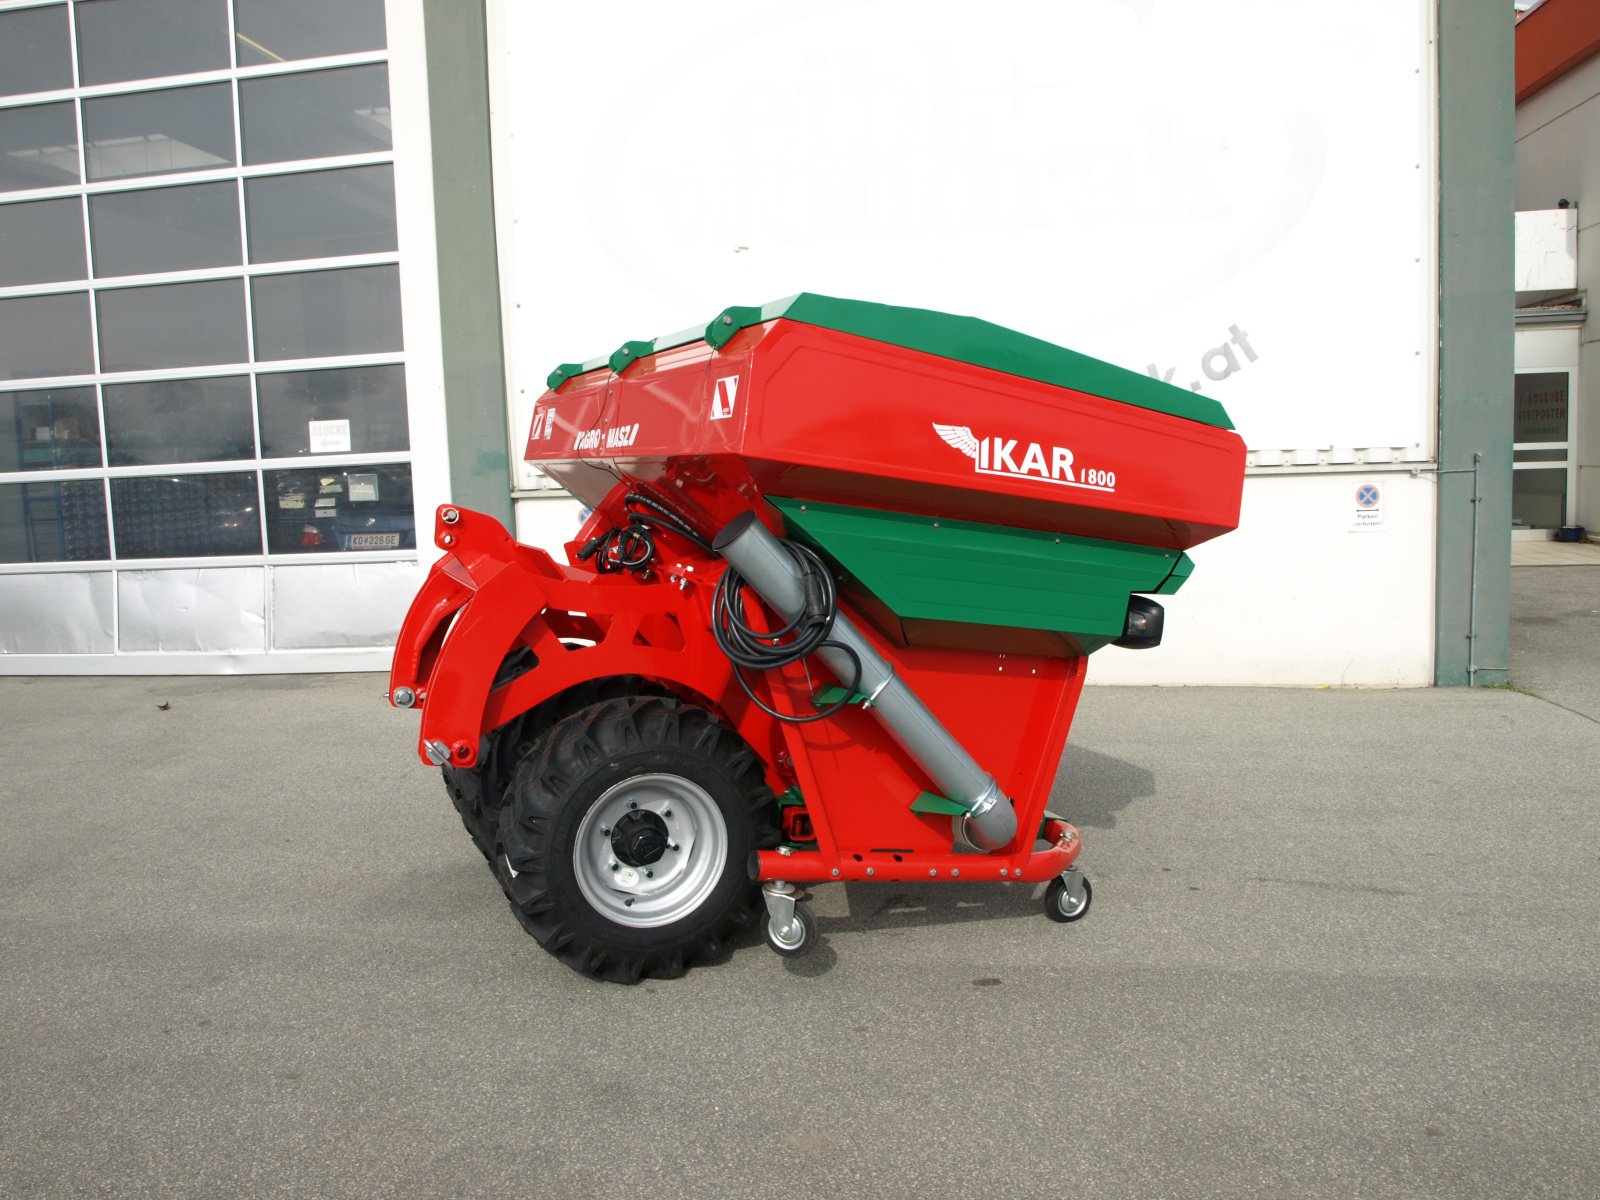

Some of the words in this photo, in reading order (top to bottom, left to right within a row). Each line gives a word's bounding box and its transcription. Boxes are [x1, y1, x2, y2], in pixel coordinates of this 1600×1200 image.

[979, 436, 1075, 481] IKAR
[1079, 468, 1117, 487] 1800
[369, 535, 385, 545] 326
[385, 535, 396, 545] GE
